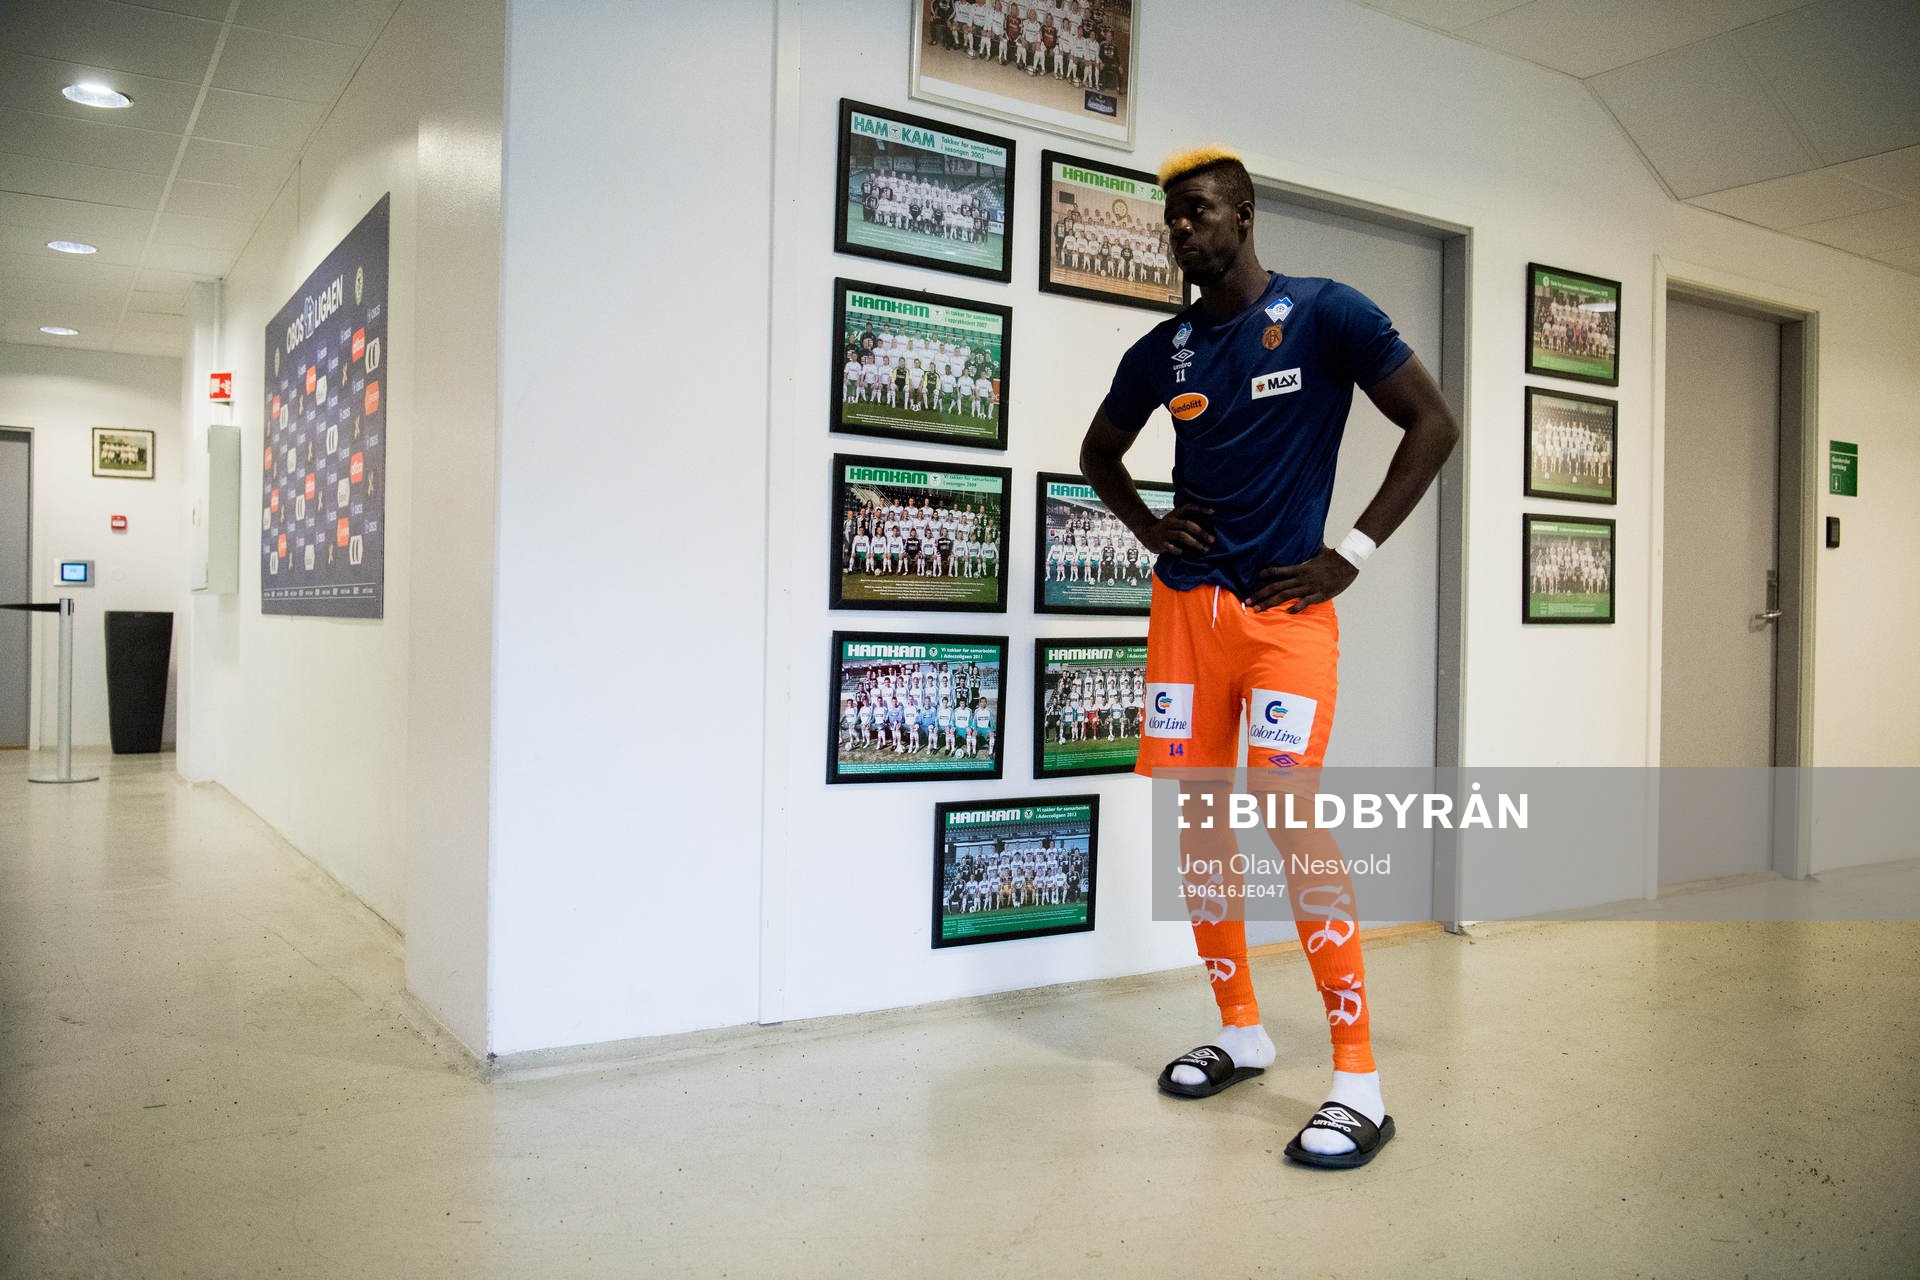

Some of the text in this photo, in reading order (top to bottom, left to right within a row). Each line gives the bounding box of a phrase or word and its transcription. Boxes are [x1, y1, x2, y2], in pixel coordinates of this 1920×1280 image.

[901, 127, 935, 148] KAM
[314, 274, 343, 329] LIGAEN
[1173, 361, 1192, 371] umbro
[1175, 369, 1186, 383] 11
[1268, 374, 1299, 390] MAX
[1165, 717, 1187, 730] Line
[1250, 724, 1302, 745] Color Line
[1169, 743, 1184, 757] 14
[1313, 1118, 1352, 1133] umbro
